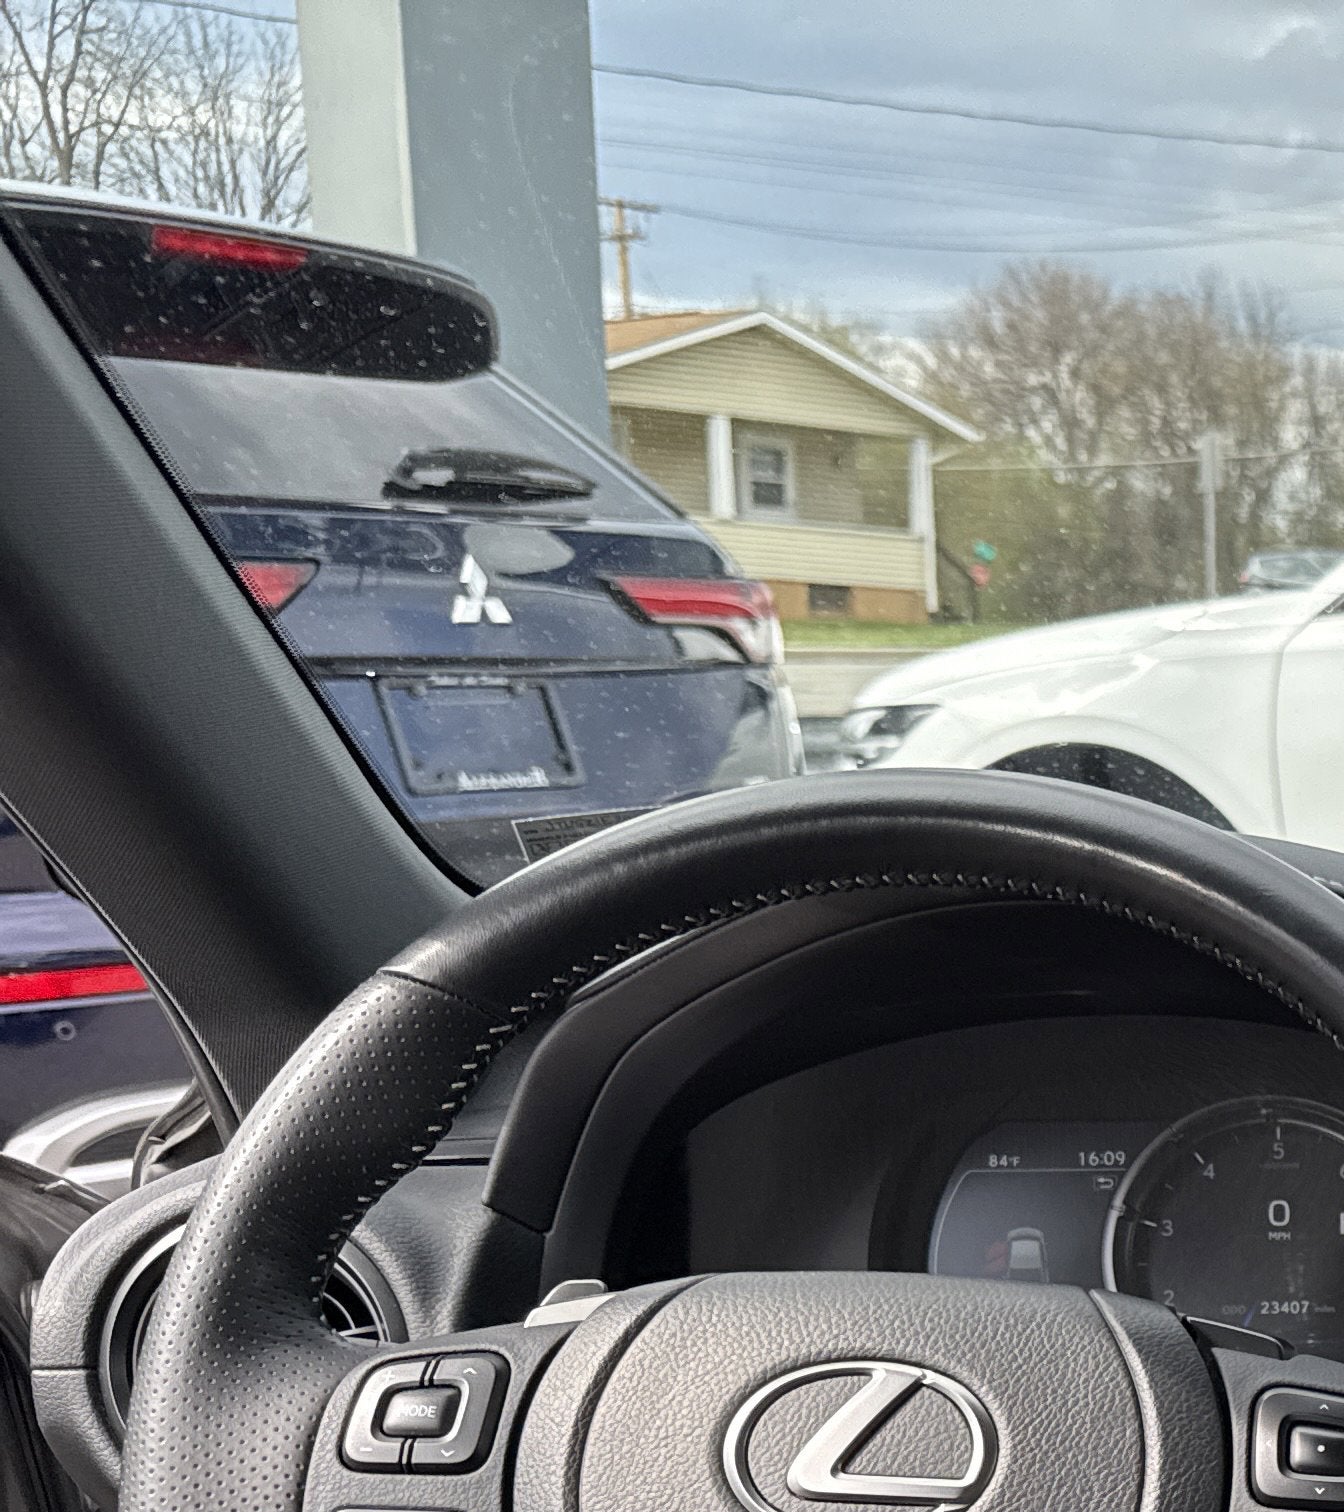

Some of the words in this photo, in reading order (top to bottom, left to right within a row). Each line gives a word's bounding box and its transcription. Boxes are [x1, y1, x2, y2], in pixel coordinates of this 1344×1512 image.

[1078, 1151, 1126, 1166] 16:09
[1272, 1142, 1285, 1160] 5
[1202, 1162, 1216, 1180] 4
[1160, 1219, 1174, 1237] 3
[1267, 1231, 1291, 1241] MPH
[1260, 1301, 1310, 1315] 23407
